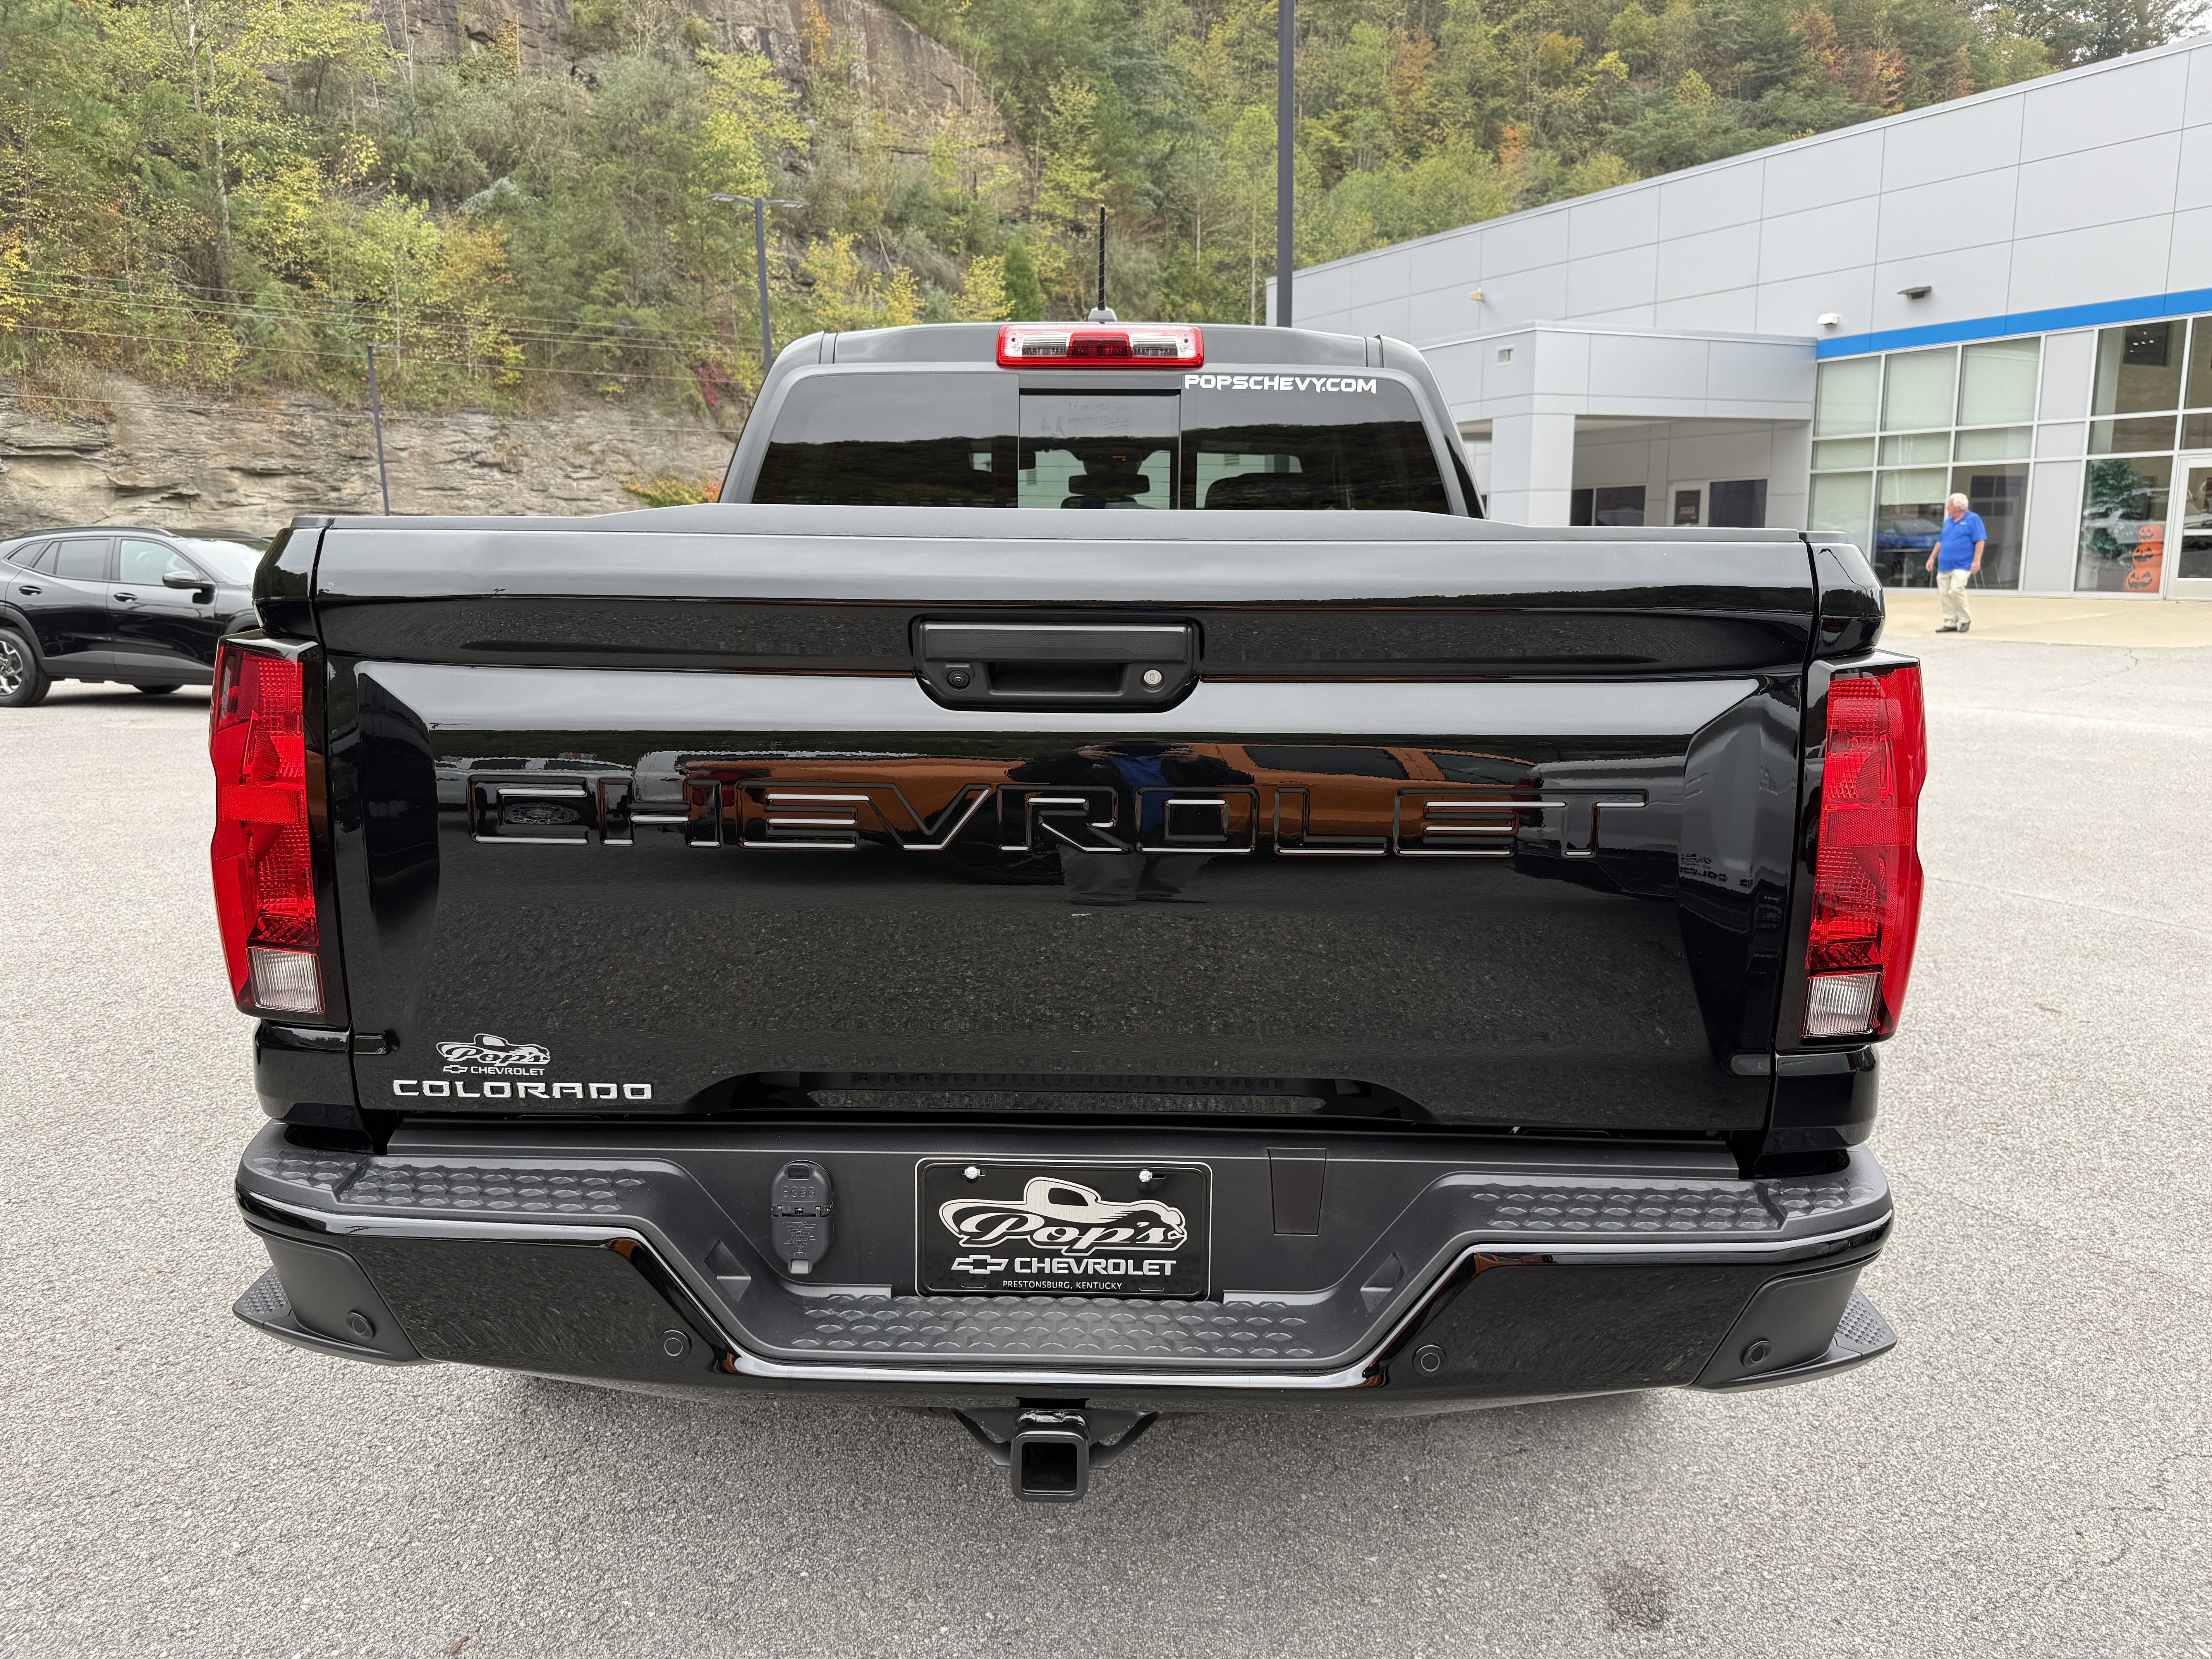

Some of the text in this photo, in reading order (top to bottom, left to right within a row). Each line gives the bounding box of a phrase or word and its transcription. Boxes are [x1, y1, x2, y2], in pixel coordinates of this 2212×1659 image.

[1184, 374, 1377, 394] POPSCHEVY.COM
[466, 775, 1649, 858] CHEVROLET
[471, 1066, 546, 1076] CHEVROLET
[393, 1079, 652, 1100] COLORADO
[959, 1212, 1173, 1249] Pop's
[1014, 1257, 1177, 1276] CHEVROLET
[1003, 1280, 1122, 1290] PRESTONSBURG, KENTUCKY
